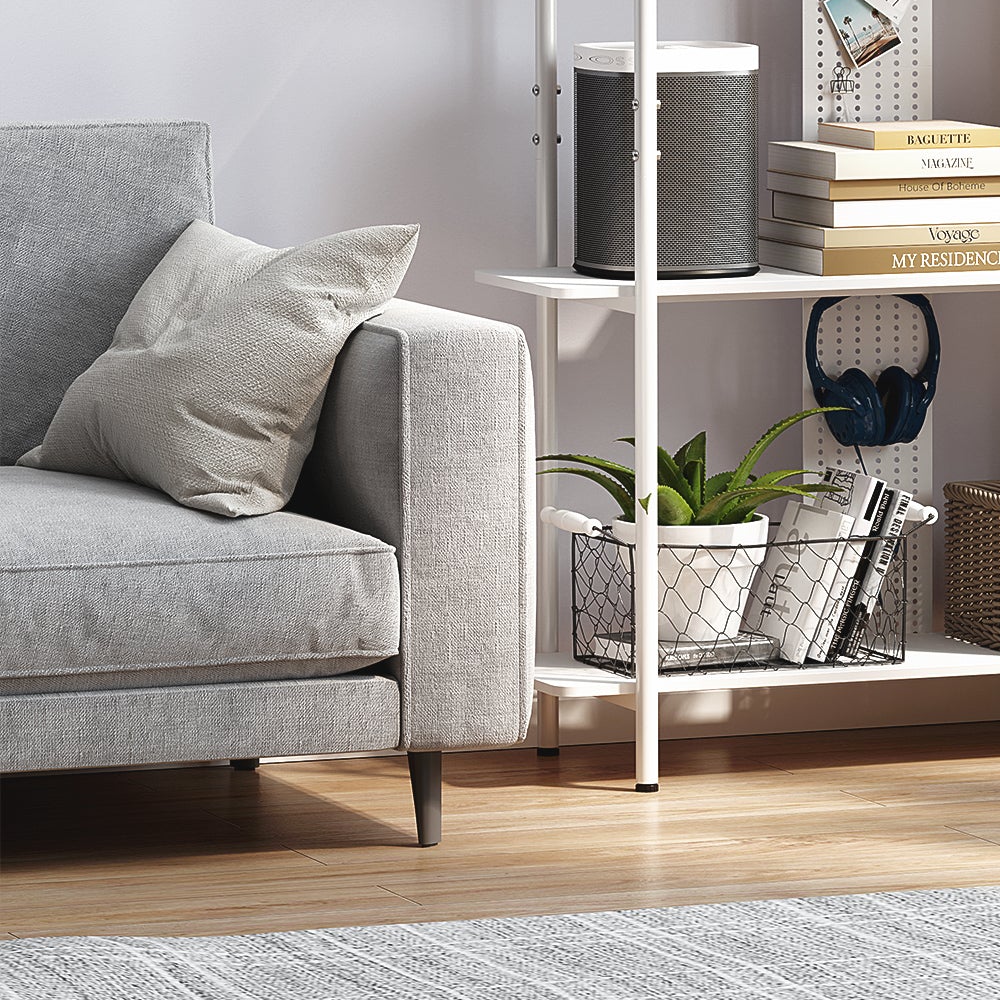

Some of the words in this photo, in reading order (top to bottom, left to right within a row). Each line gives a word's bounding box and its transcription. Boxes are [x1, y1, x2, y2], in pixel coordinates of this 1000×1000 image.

[907, 134, 972, 145] BAGUETTE
[921, 158, 975, 169] MAGAZINE
[899, 183, 929, 192] House
[931, 182, 945, 191] Of
[946, 181, 986, 190] Boheme
[929, 227, 980, 244] Voyage
[892, 254, 918, 269] MY
